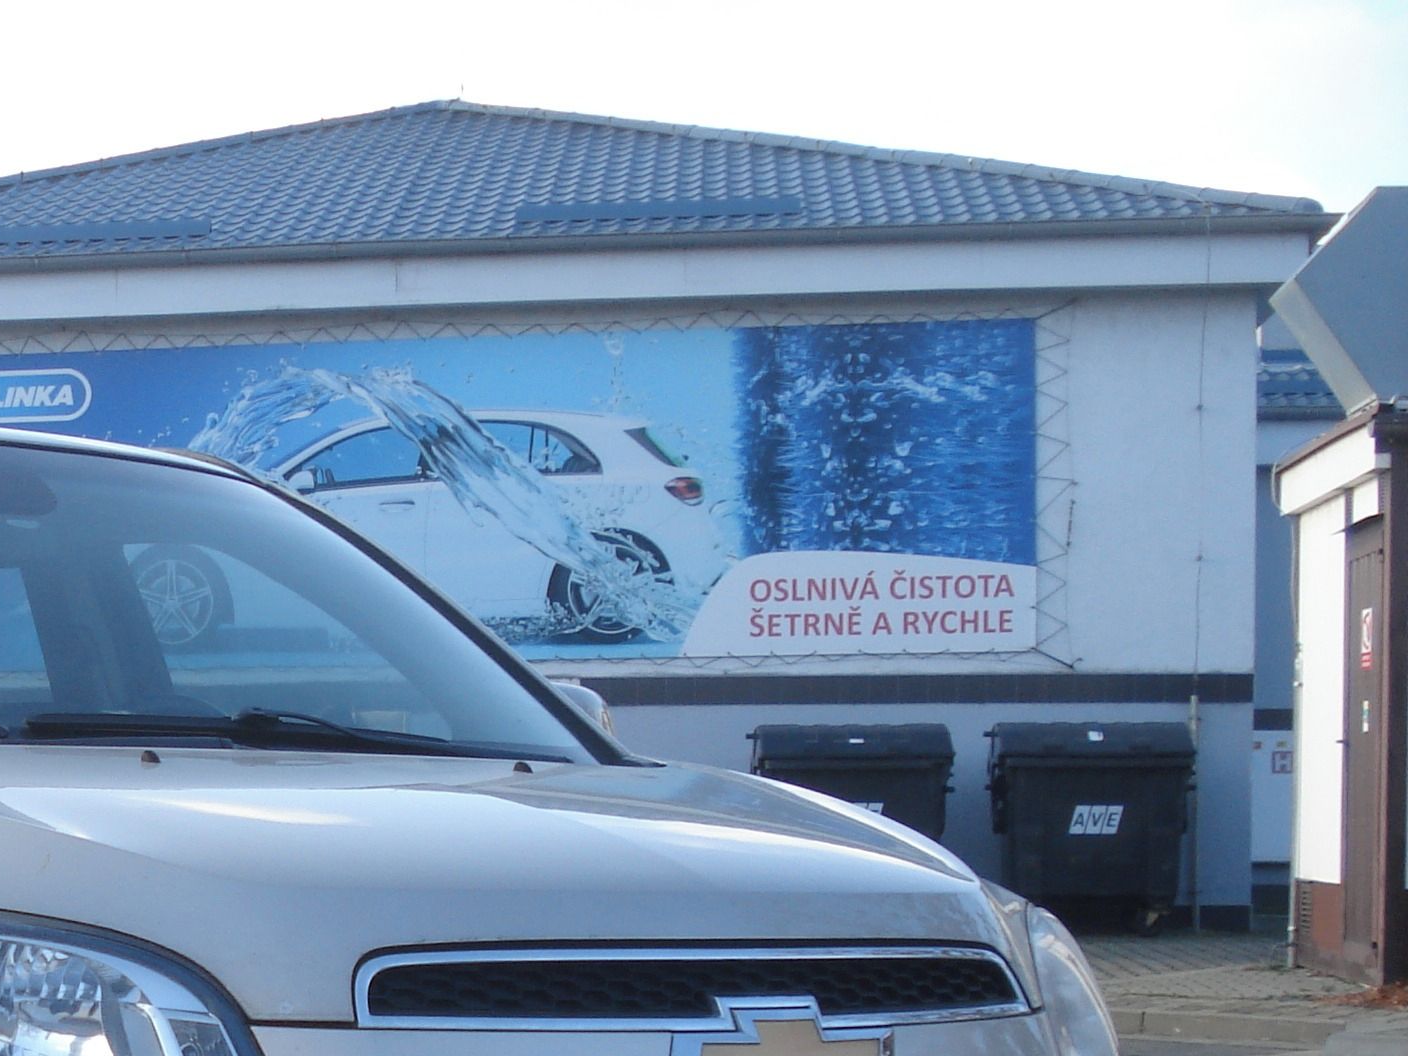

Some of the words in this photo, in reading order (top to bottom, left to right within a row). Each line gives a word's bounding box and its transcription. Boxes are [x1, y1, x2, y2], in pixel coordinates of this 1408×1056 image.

[749, 570, 880, 603] OSLNIVÁ
[889, 569, 1015, 600] ČISTOTA
[749, 606, 863, 638] ŠETRNĚ
[871, 611, 893, 636] A
[903, 609, 1014, 635] RYCHLE
[1072, 812, 1120, 828] AVE
